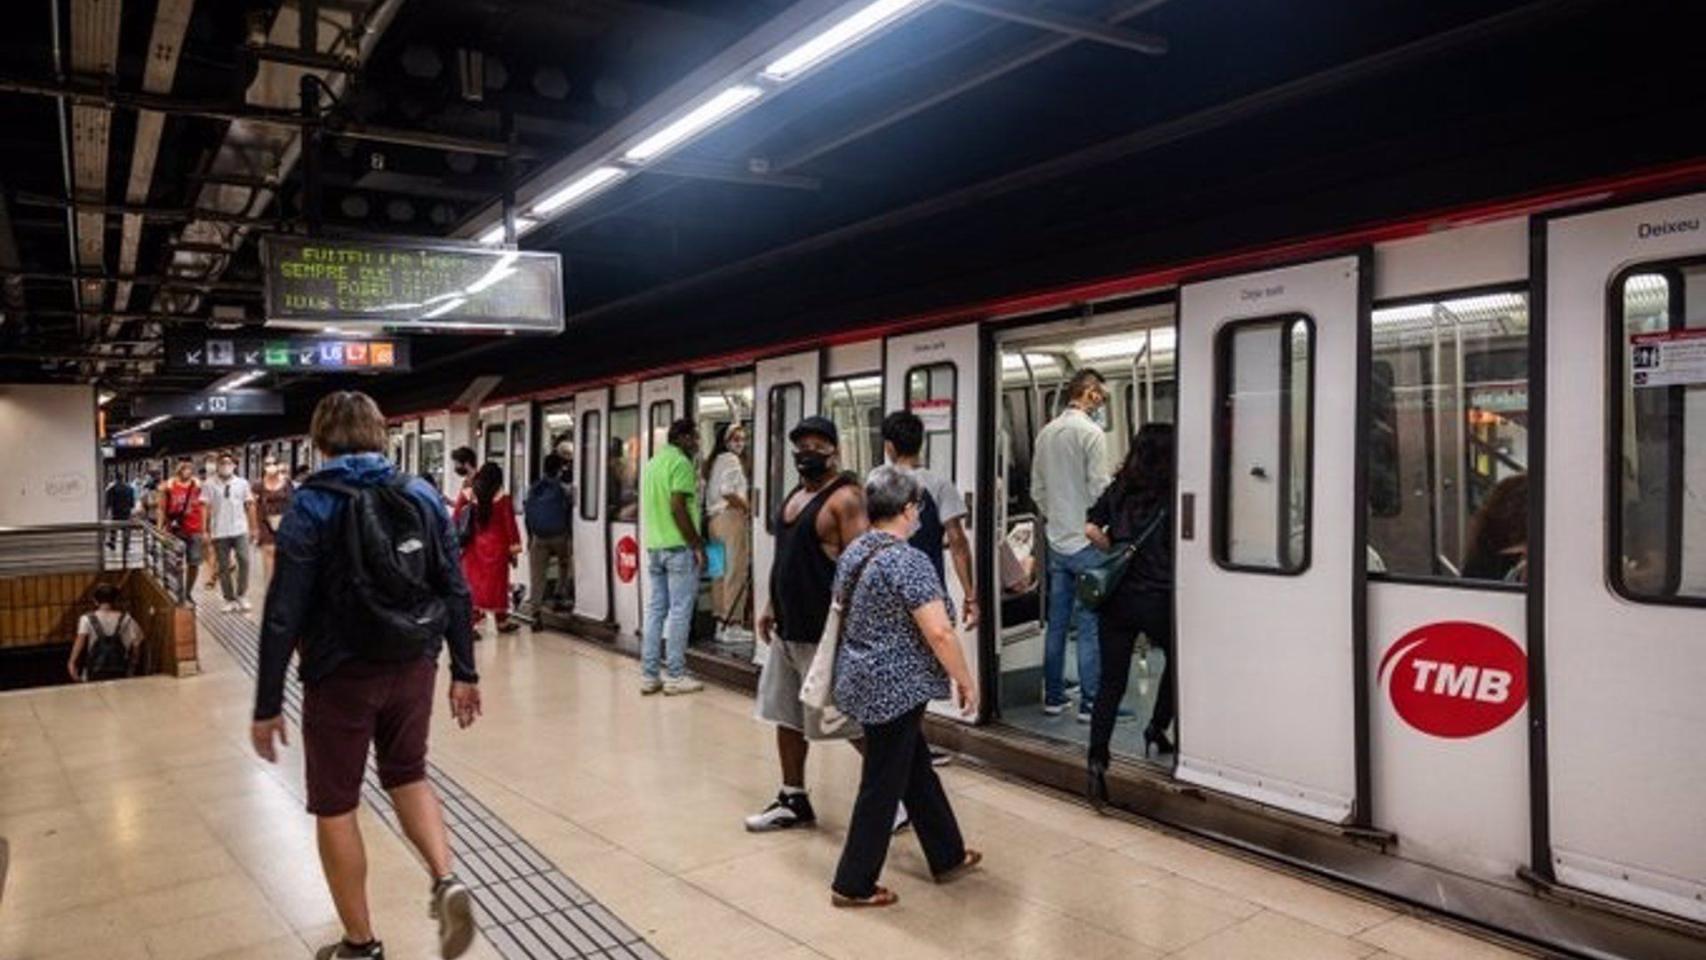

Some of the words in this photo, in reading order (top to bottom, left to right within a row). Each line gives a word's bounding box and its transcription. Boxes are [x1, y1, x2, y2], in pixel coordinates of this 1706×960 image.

[1638, 217, 1699, 239] Deixeu
[281, 262, 349, 280] SEMPRE
[321, 343, 342, 361] L6
[1412, 658, 1513, 705] TMB
